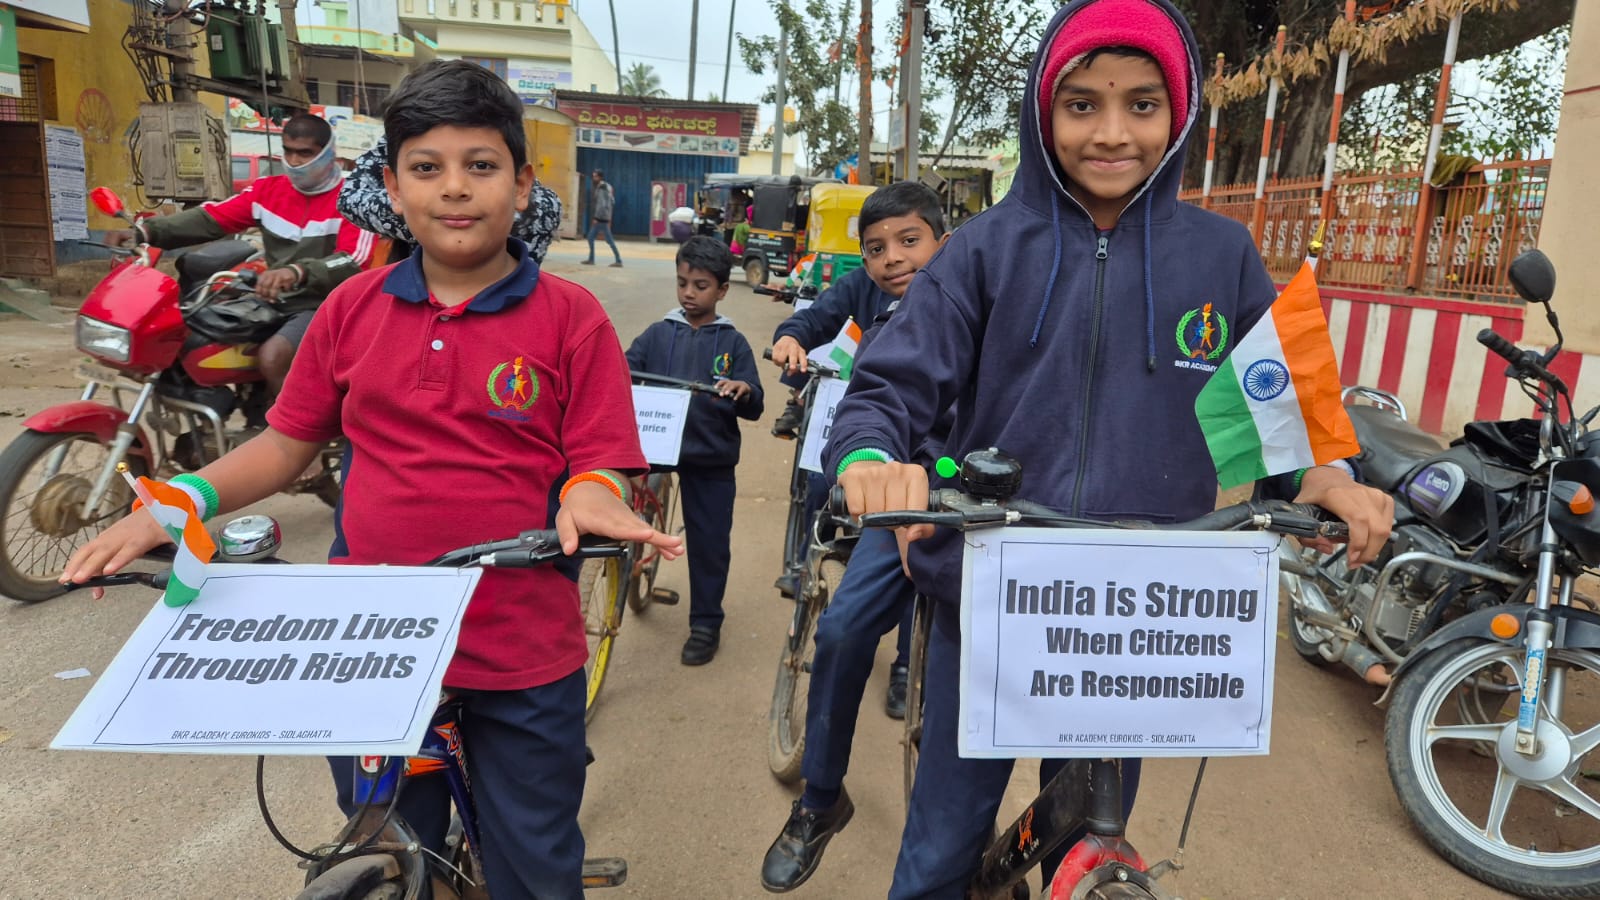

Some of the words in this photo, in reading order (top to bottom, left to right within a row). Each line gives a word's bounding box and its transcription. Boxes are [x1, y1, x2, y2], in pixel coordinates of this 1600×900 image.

[639, 410, 653, 418] not
[641, 424, 667, 434] price
[1006, 579, 1096, 616] India
[1106, 580, 1137, 618] is
[1145, 582, 1259, 623] Strong
[171, 614, 339, 643] Freedom
[341, 613, 440, 641] Lives
[1046, 627, 1122, 655] When
[1129, 628, 1232, 657] Citizens
[148, 652, 299, 685] Through
[299, 651, 417, 684] Rights
[1029, 670, 1075, 697] Are
[1081, 670, 1245, 701] Responsible
[171, 730, 190, 740] BKR
[230, 730, 271, 740] EUROKIDS
[279, 729, 333, 739] SIDLAGHATTA
[1058, 733, 1074, 743] BKR
[1110, 734, 1144, 744] EUROKIDS
[1151, 734, 1196, 744] SIDLAGHATTA
